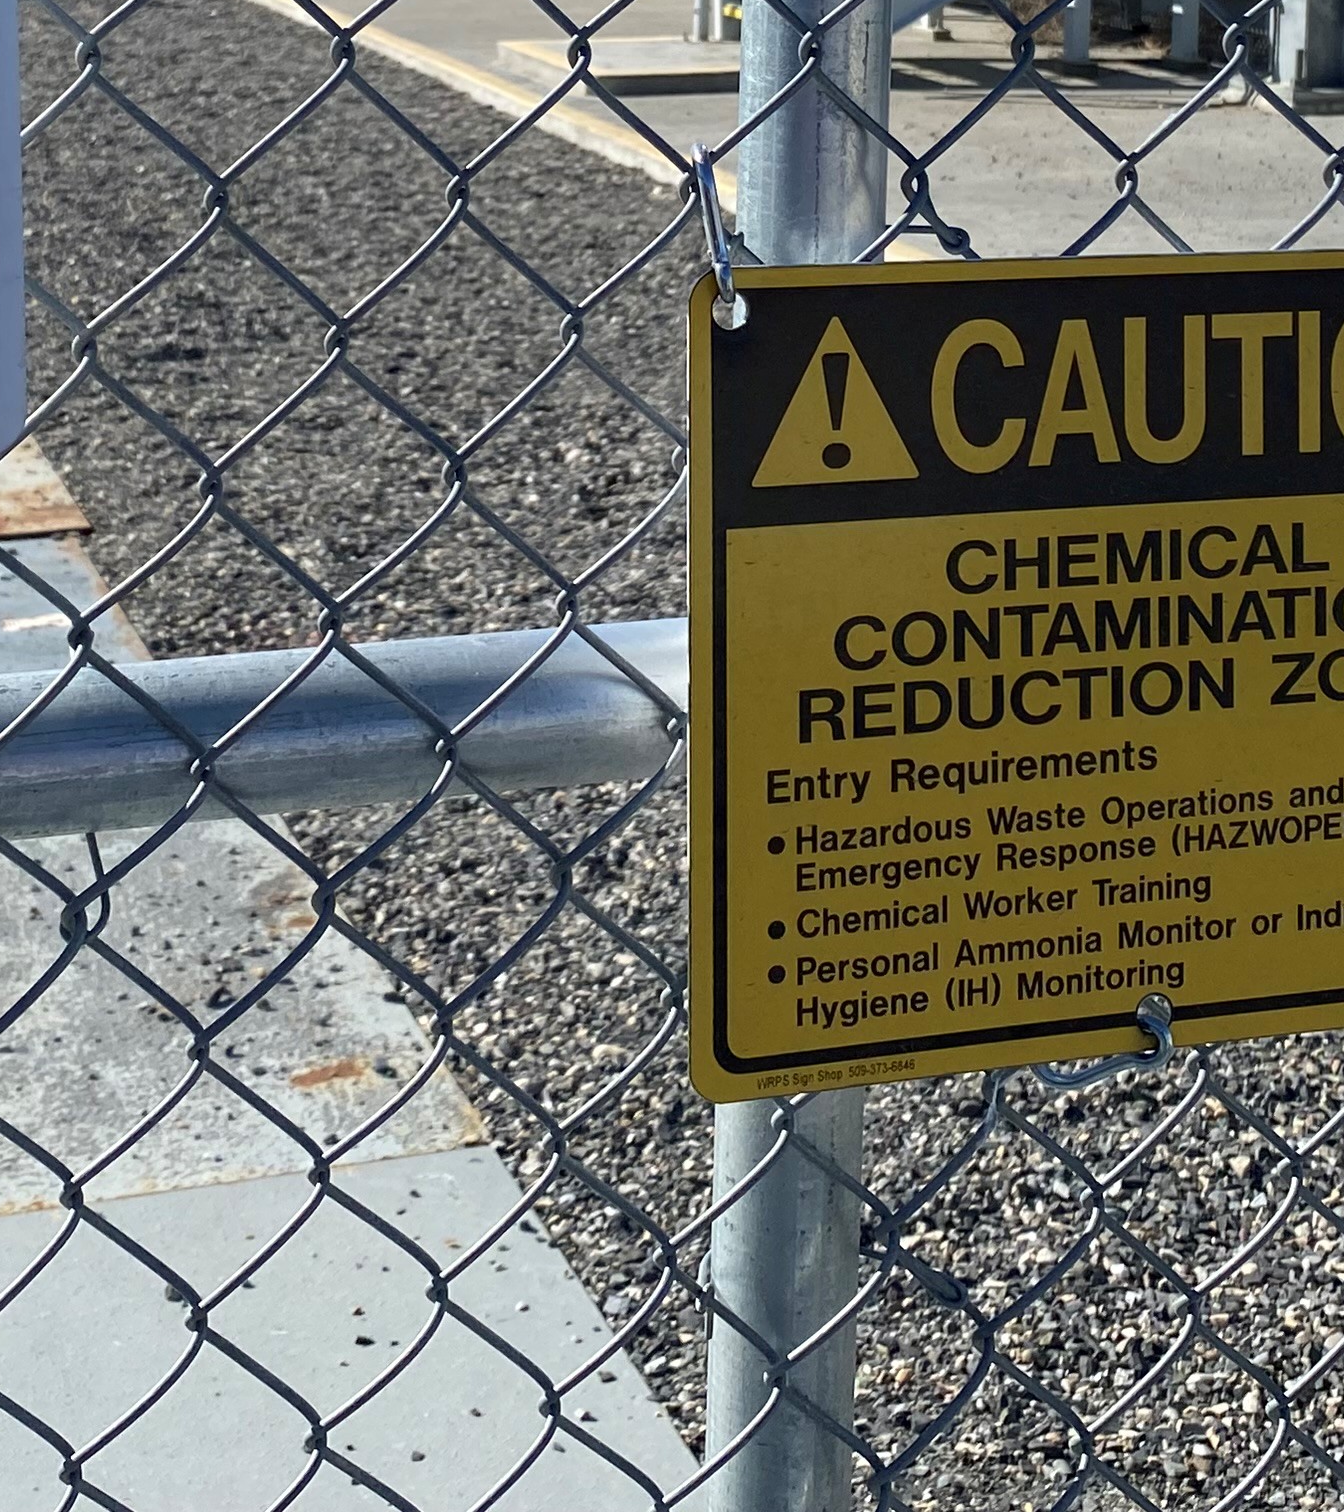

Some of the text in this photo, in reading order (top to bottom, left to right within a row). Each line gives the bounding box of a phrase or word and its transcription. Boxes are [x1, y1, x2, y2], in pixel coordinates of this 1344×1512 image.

[946, 523, 1329, 594] CHEMICAL
[799, 658, 1234, 743] REDUCTION
[768, 741, 1157, 805] Entry Requirements
[797, 777, 1344, 854] Hazardous Waste Operations and
[797, 853, 980, 892] Emergency
[997, 837, 1155, 875] Response
[797, 873, 1210, 938] Chemical Worker Training
[797, 943, 938, 985] Personal
[955, 927, 1101, 967] Ammonia
[1119, 915, 1236, 949] Monitor
[1252, 913, 1282, 935] or
[797, 959, 1184, 1029] Hygiene (IH) Monitoring
[756, 1074, 790, 1090] WRPS
[792, 1072, 814, 1087] Sign
[818, 1069, 843, 1083] Shop
